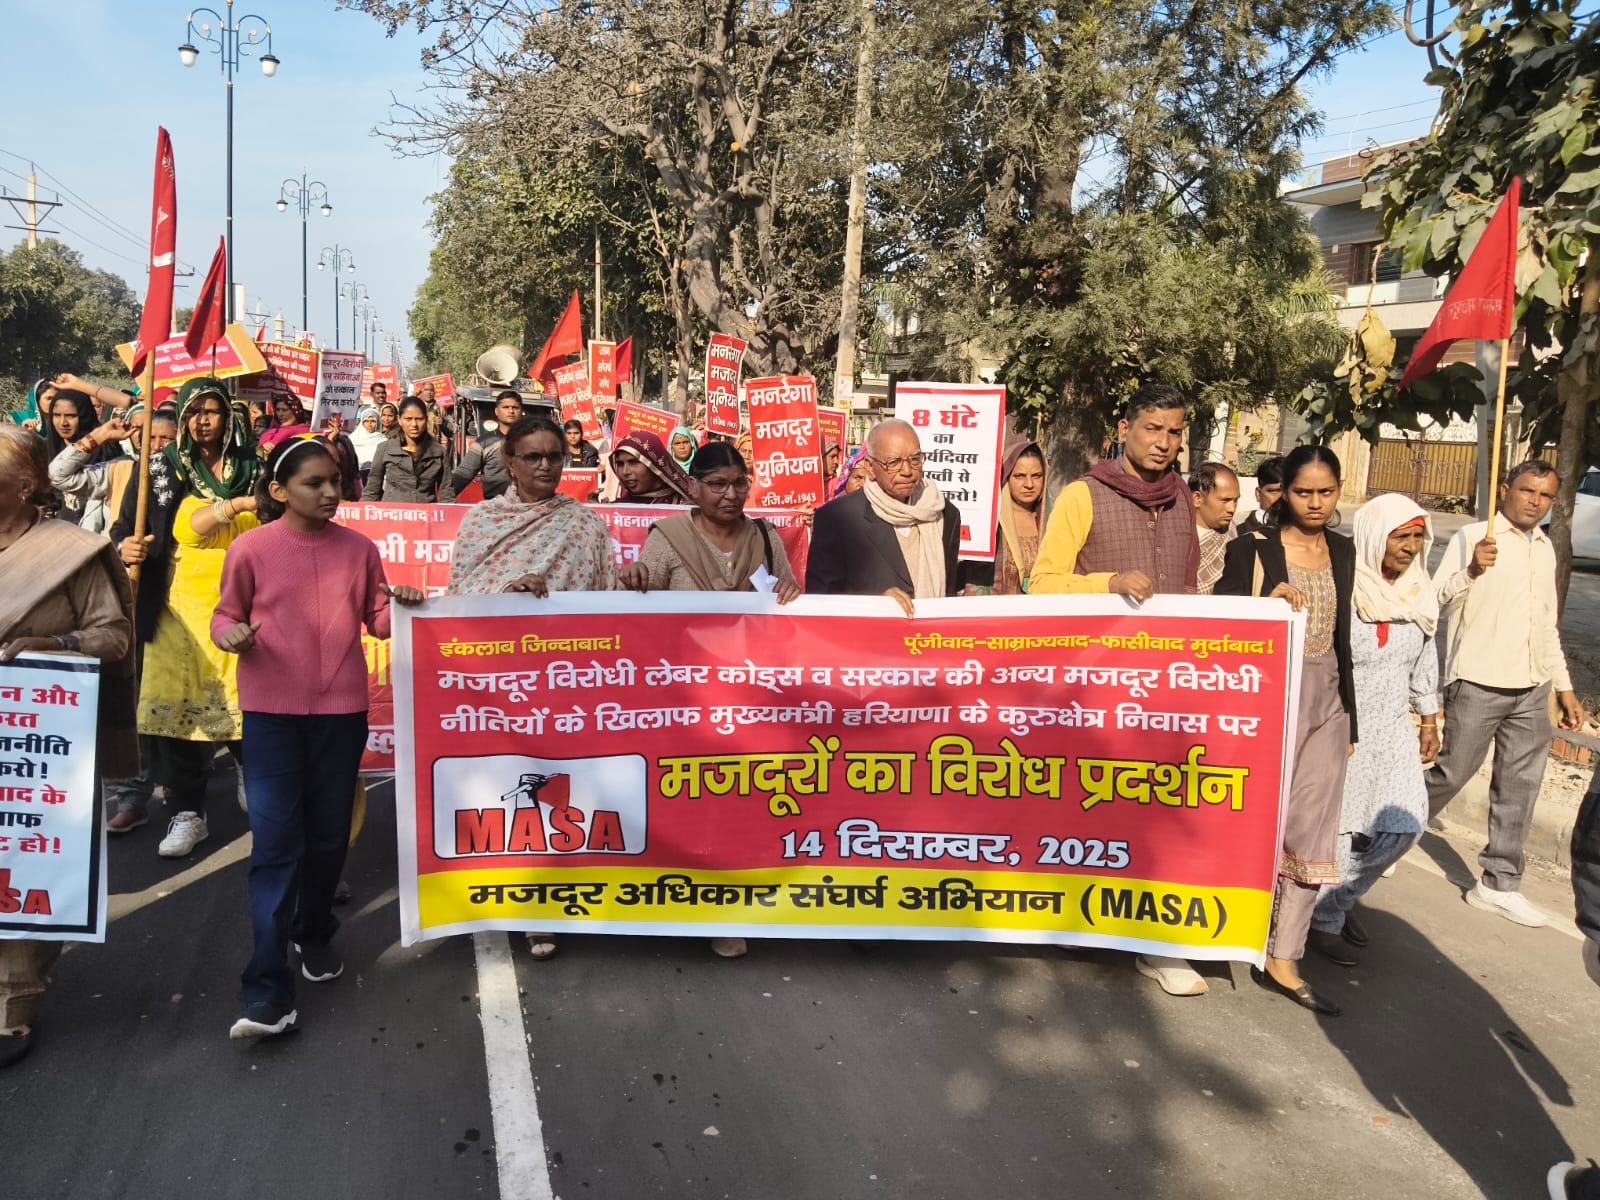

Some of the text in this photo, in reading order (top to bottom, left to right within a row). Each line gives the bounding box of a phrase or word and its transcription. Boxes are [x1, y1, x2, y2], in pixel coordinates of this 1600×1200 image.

[710, 341, 742, 363] मनरेगा
[749, 379, 812, 407] मनरेगा
[912, 404, 980, 428] 8 घंटे
[755, 418, 813, 446] मजदूर
[933, 433, 955, 444] का
[957, 468, 971, 484] से
[364, 505, 428, 521] जिन्दाबाद
[438, 634, 621, 657] इंकलाब जिन्दाबाद!
[1190, 635, 1274, 659] मुर्दाबाद!
[438, 658, 1262, 702] मजदूर विरोधी लेबर कोड्स व सरकार की अन्य मजदूर विरोधी
[32, 684, 80, 706] और
[440, 698, 1261, 736] नीतियों के खिलाफ मुख्यमंत्री हरियाणा के कुरुक्षेत्र निवास पर
[658, 734, 1249, 817] मजदूरों का विरोध प्रदर्शन
[40, 784, 67, 805] के
[455, 807, 626, 855] MASA
[781, 817, 1131, 869] 14 दिसम्बर, 2025
[18, 833, 61, 854] हो!
[469, 874, 1229, 939] मजदूर अधिकार संघर्ष अभियान (MASA)
